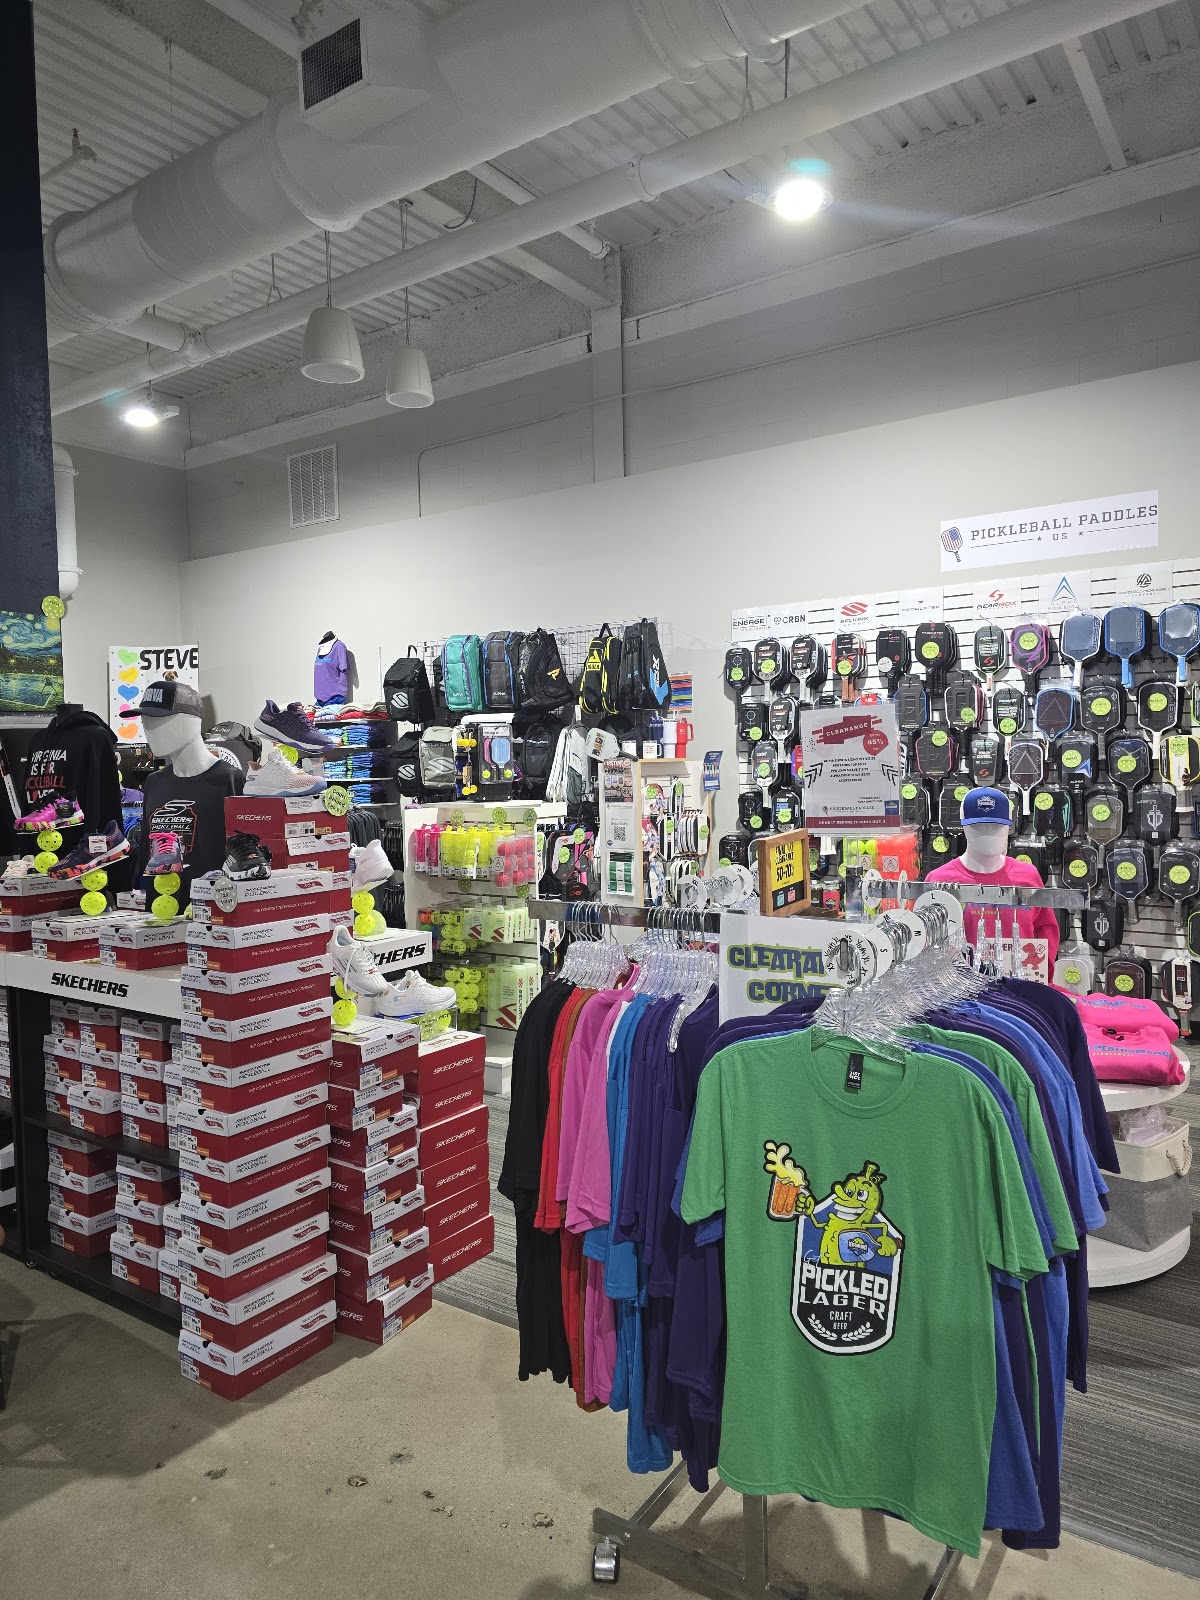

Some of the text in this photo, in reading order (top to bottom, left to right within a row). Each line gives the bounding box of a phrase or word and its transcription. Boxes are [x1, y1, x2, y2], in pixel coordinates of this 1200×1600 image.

[970, 504, 1158, 541] PICKLEBALL PADDLES
[1052, 532, 1067, 541] US
[733, 618, 764, 627] ENGAGE
[783, 615, 806, 624] CRBN
[140, 648, 198, 670] STEVE
[826, 722, 869, 737] CLEARANCE
[31, 764, 38, 776] IS
[728, 945, 824, 977] CLEARA
[51, 972, 129, 998] SKECHERS
[748, 980, 842, 1003] CORNE
[1094, 1044, 1172, 1059] PERFORMANC
[433, 1056, 473, 1075] SKECHERS
[435, 1090, 472, 1108] SKECHERS
[435, 1127, 476, 1149] SKECHERS
[436, 1164, 477, 1188] SKECHERS
[439, 1201, 479, 1226] SKECHERS
[442, 1238, 482, 1265] SKECHERS
[802, 1262, 888, 1300] PICKLED
[800, 1285, 885, 1320] LAGER
[829, 1311, 852, 1321] CRAFT
